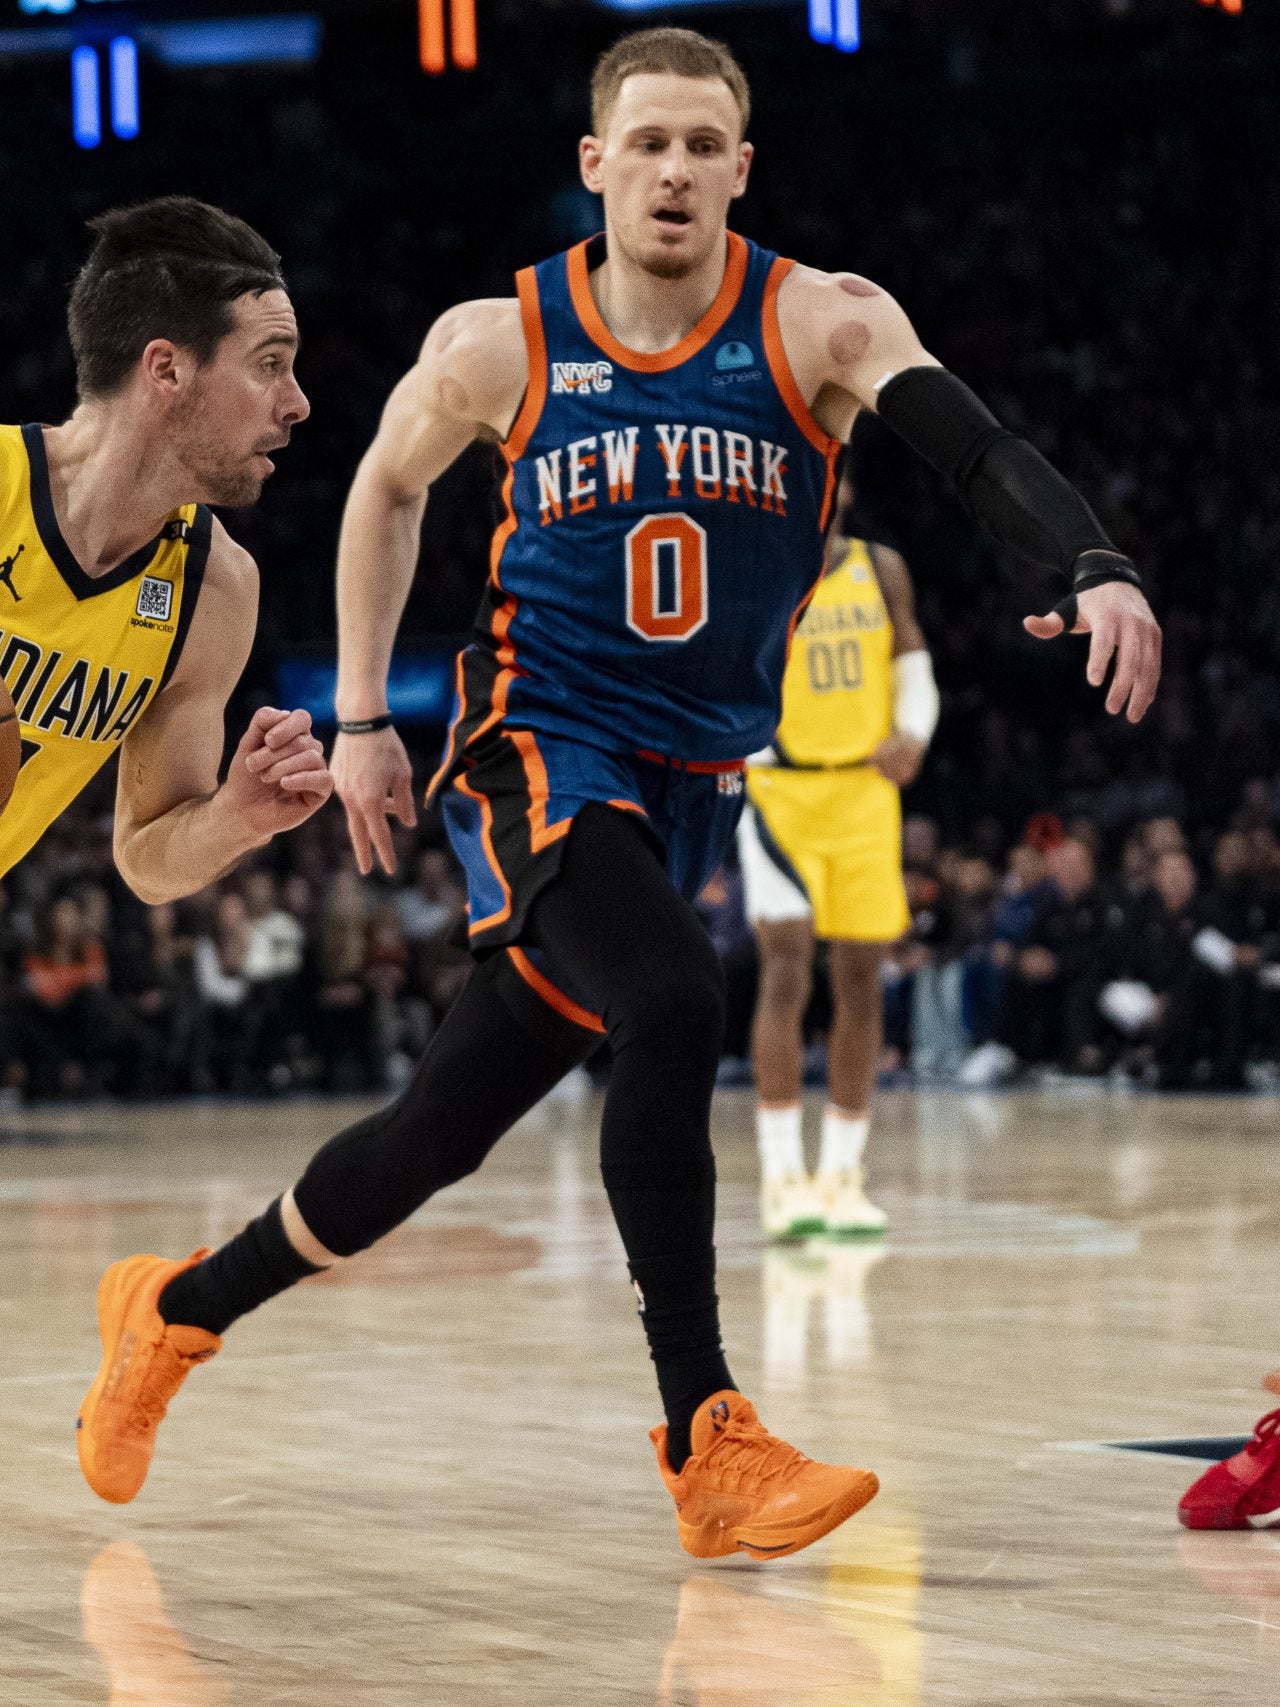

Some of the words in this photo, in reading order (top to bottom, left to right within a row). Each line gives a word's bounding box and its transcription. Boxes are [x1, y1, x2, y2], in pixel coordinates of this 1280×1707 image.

[552, 361, 613, 394] NYC
[535, 425, 640, 527] NEW
[655, 424, 789, 518] YORK
[624, 512, 709, 642] 0
[806, 638, 863, 693] 00
